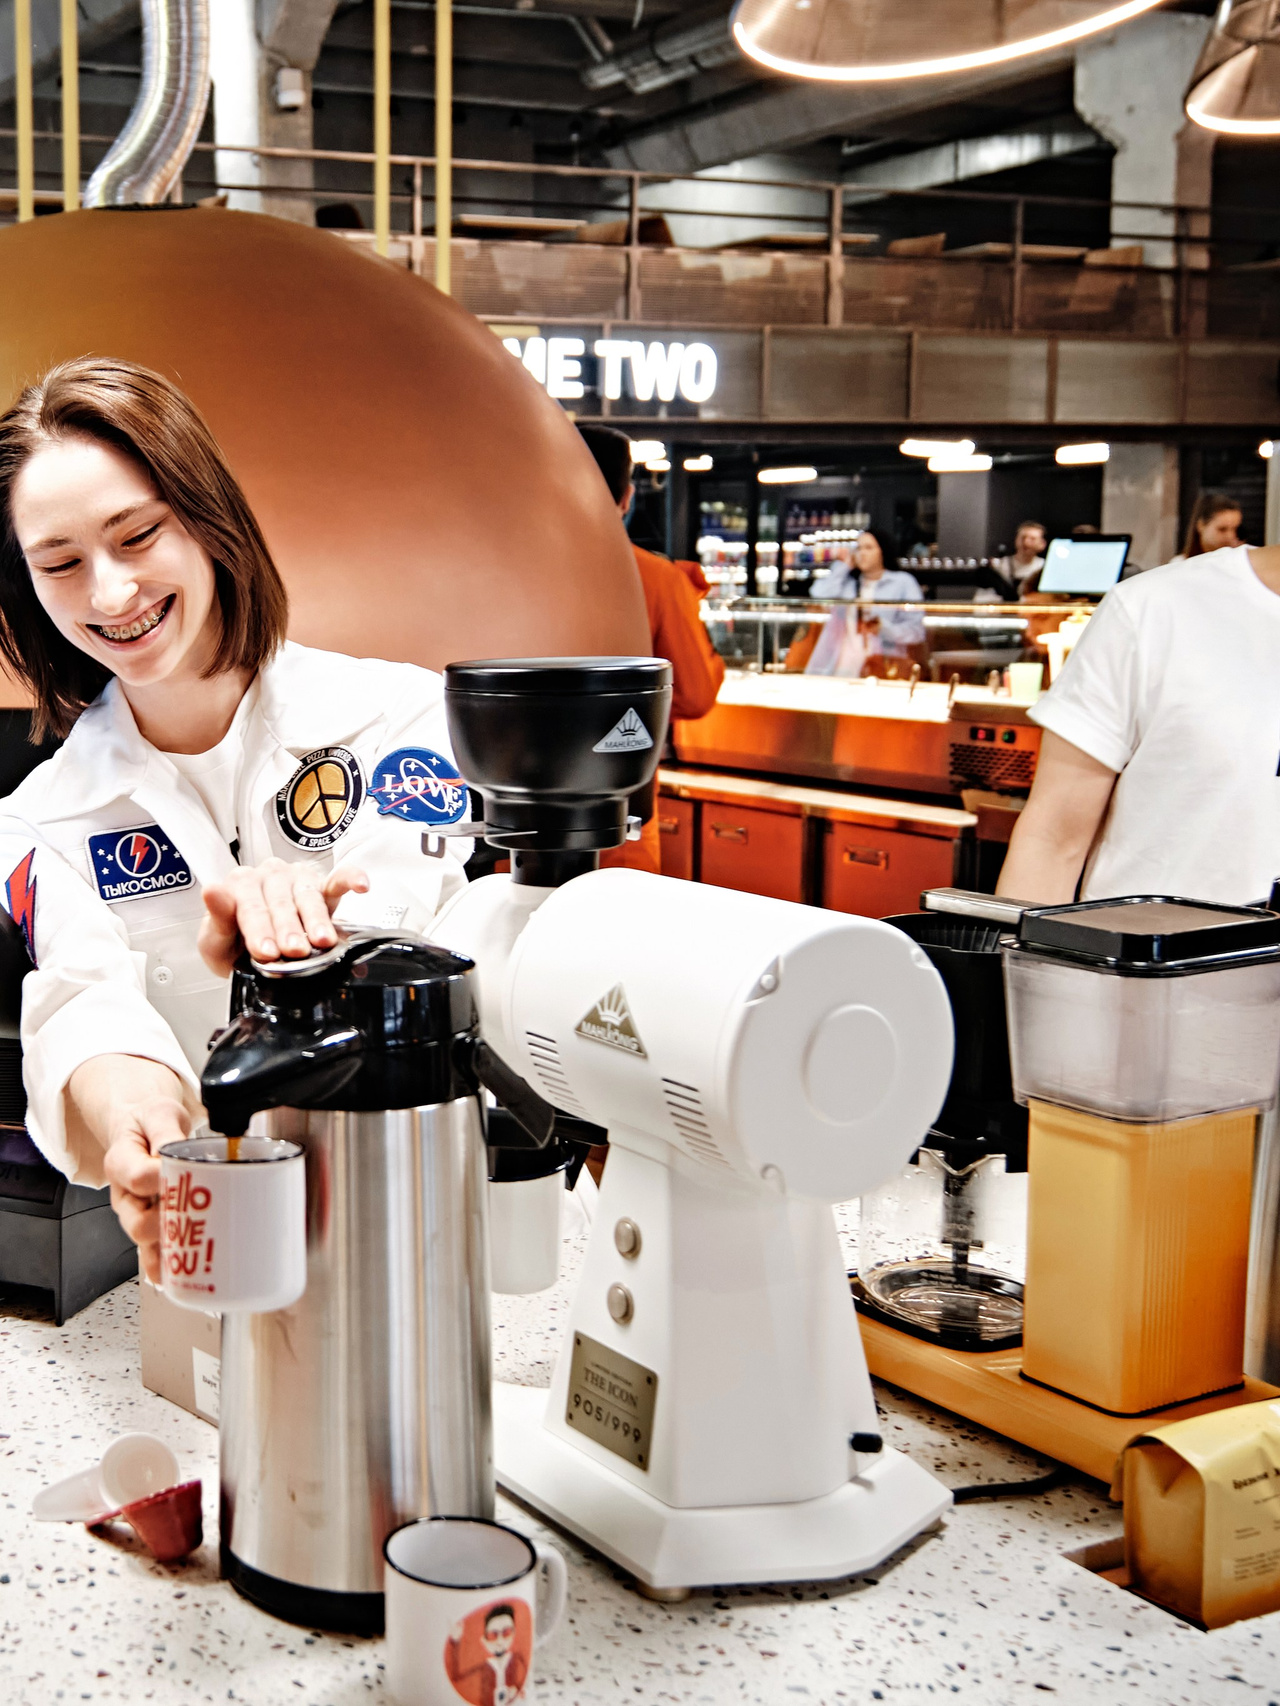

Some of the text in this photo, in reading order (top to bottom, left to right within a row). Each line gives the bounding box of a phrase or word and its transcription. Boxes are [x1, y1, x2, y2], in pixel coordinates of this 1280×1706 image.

[594, 339, 718, 403] TWO
[306, 749, 326, 764] PIZZA
[381, 773, 464, 809] LOVE
[298, 806, 358, 847] IN SPACE WE LOVE
[102, 870, 189, 898] ТЫКОСМОС
[584, 1366, 638, 1409] THE ICON
[573, 1393, 642, 1443] 905/999
